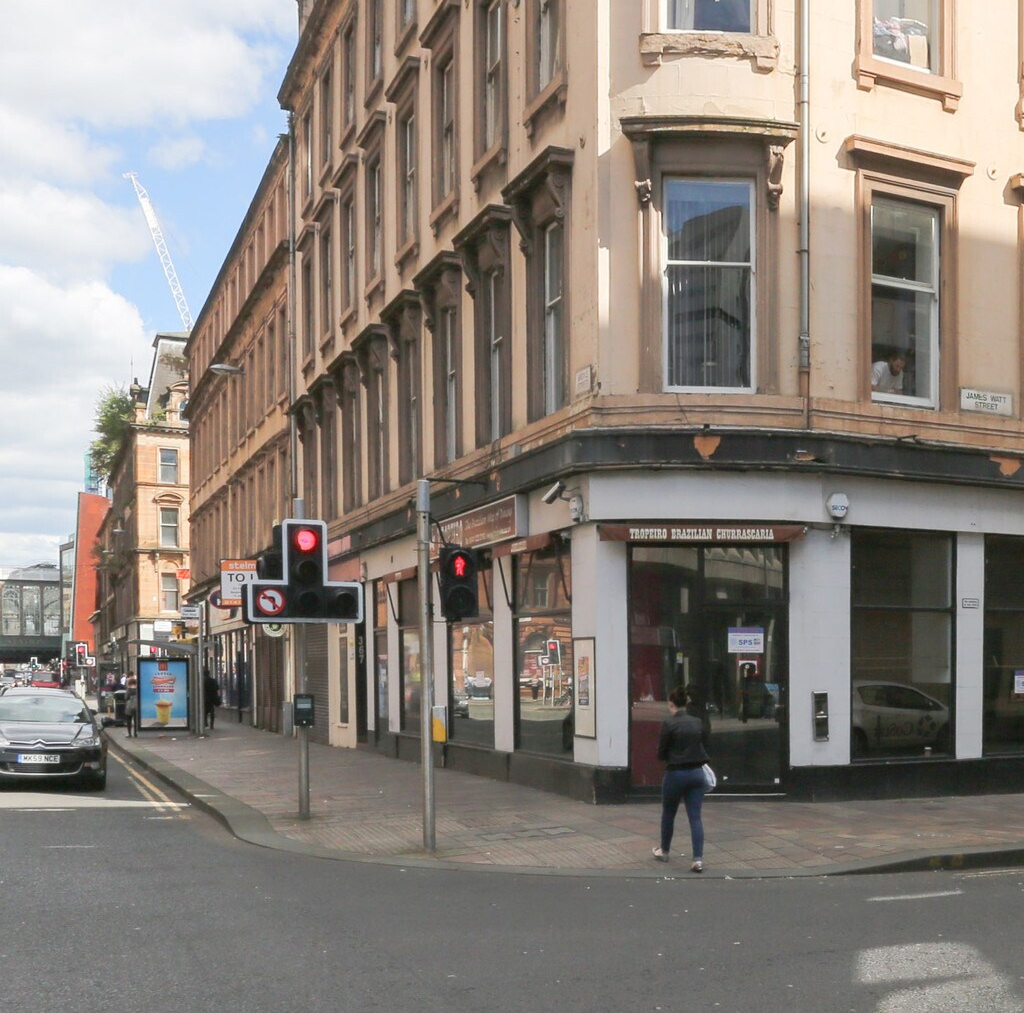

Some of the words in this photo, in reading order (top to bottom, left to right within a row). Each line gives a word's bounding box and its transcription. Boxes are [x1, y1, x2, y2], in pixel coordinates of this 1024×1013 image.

[966, 392, 988, 401] JAMES
[990, 395, 1007, 403] WATT
[974, 401, 999, 410] STREET
[629, 528, 668, 539] TROPEIRO
[671, 528, 713, 539] BRAZILIAN
[716, 528, 774, 540] CHURRASCARIA
[227, 573, 245, 582] TO
[44, 755, 59, 763] NCE
